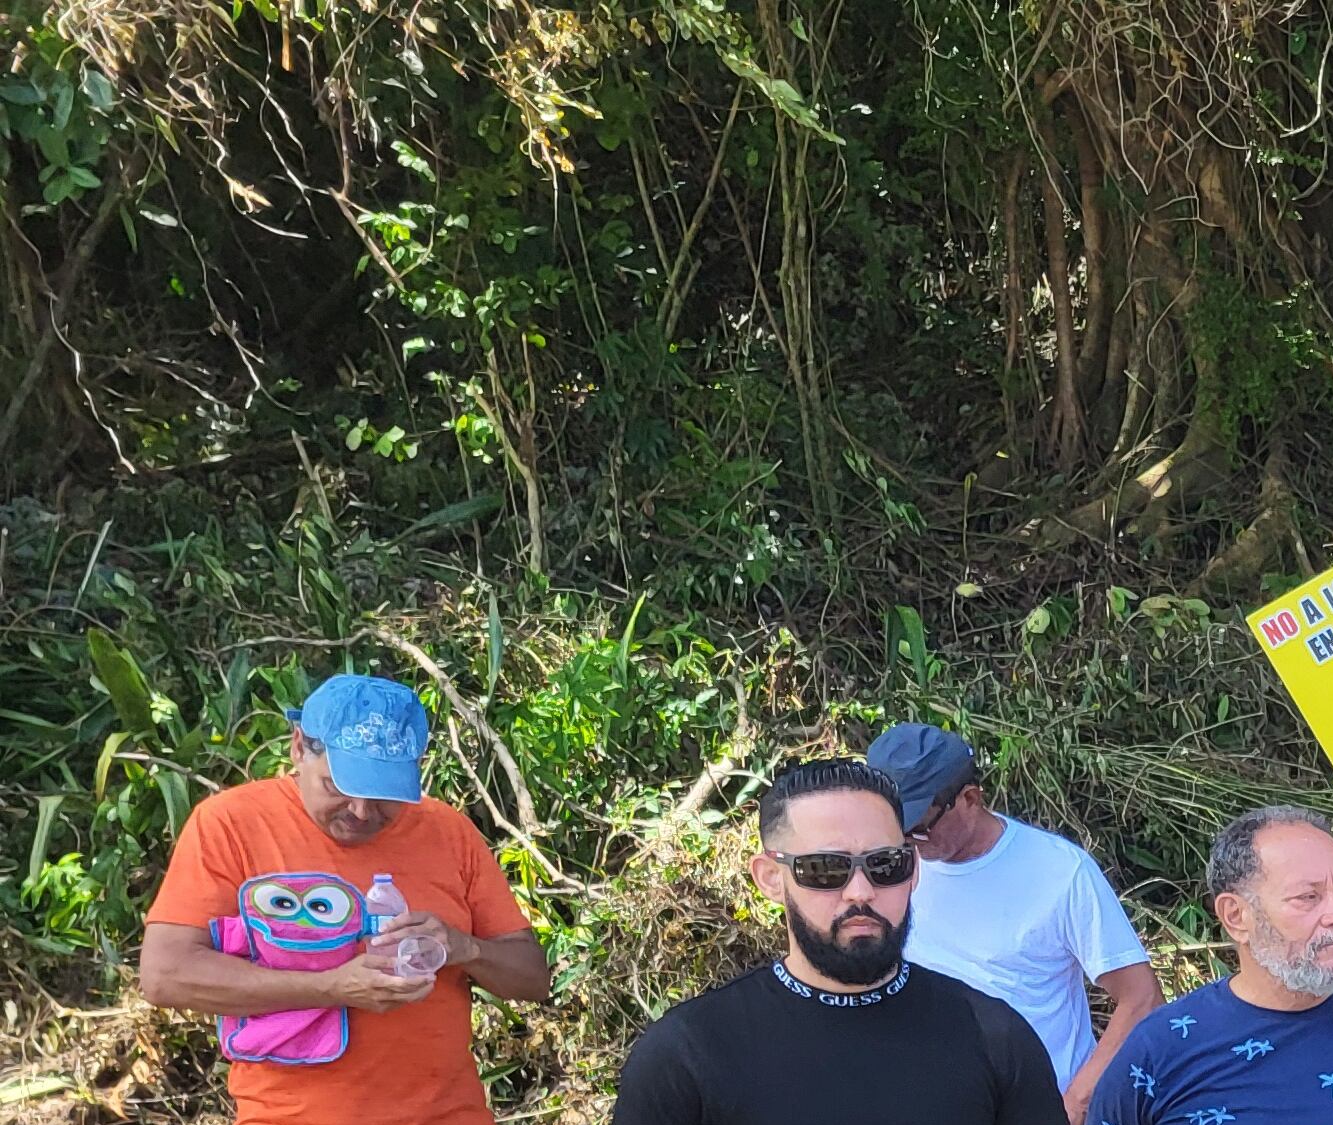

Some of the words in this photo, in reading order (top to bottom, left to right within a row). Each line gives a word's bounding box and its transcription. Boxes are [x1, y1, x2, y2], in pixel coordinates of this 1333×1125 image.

[1261, 611, 1298, 646] NO
[1301, 598, 1324, 625] A
[773, 963, 812, 998] GUESS
[819, 992, 882, 1007] GUESS
